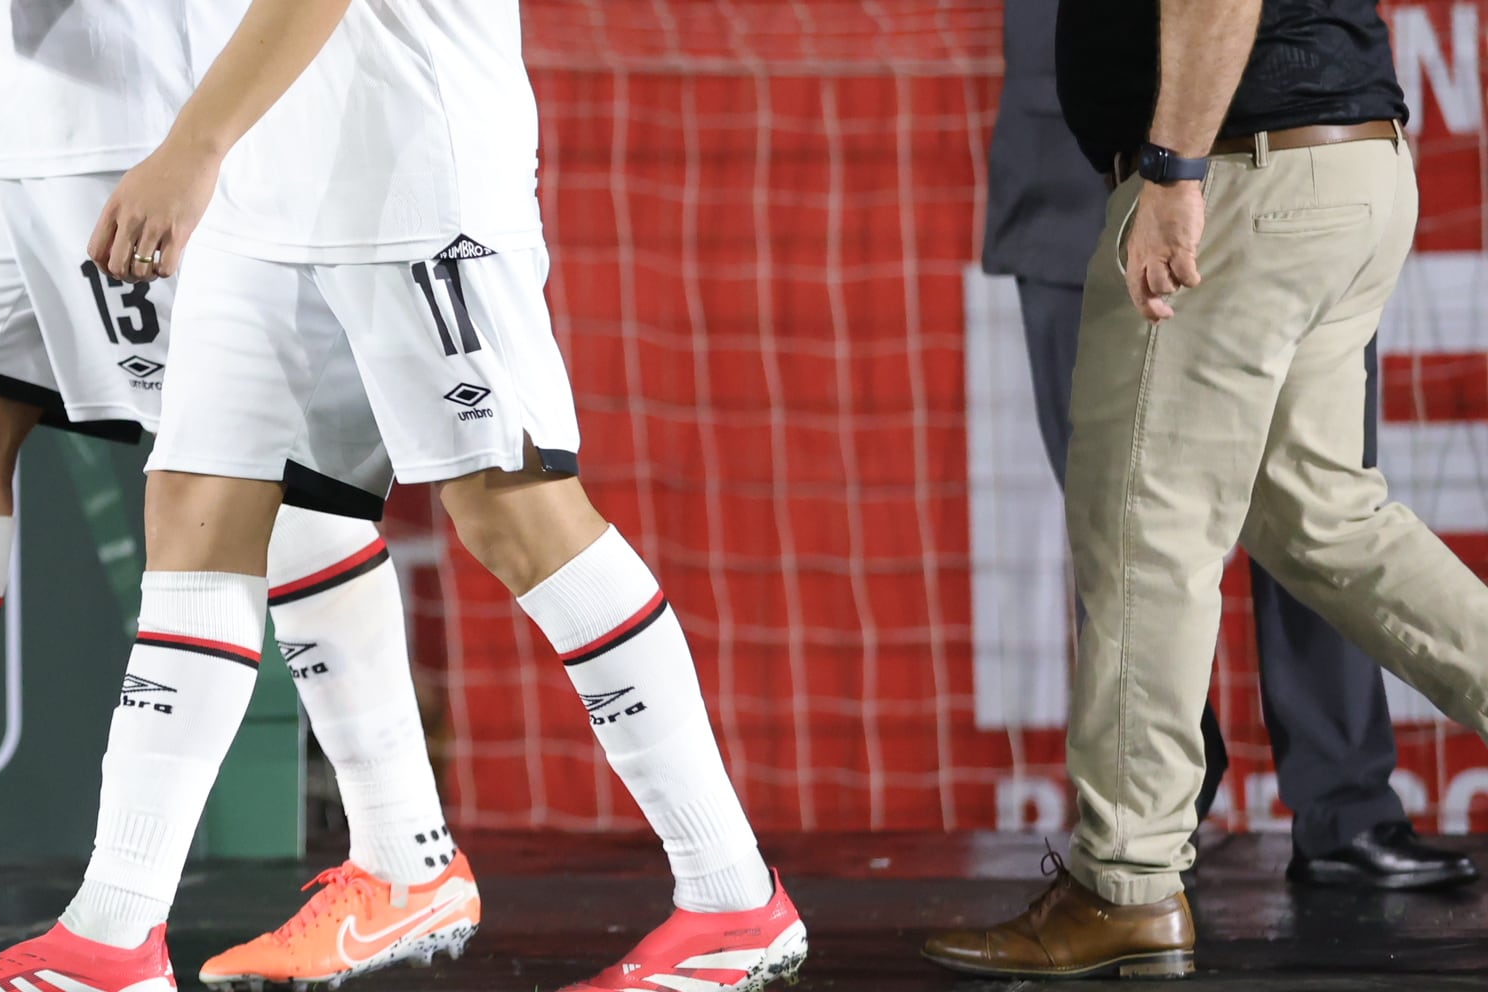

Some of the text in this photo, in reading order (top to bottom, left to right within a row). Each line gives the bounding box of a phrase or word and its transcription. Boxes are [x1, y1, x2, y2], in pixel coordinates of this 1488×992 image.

[448, 239, 484, 259] UMBRO
[80, 260, 161, 346] 13
[411, 260, 482, 357] 11
[457, 406, 494, 422] umbro
